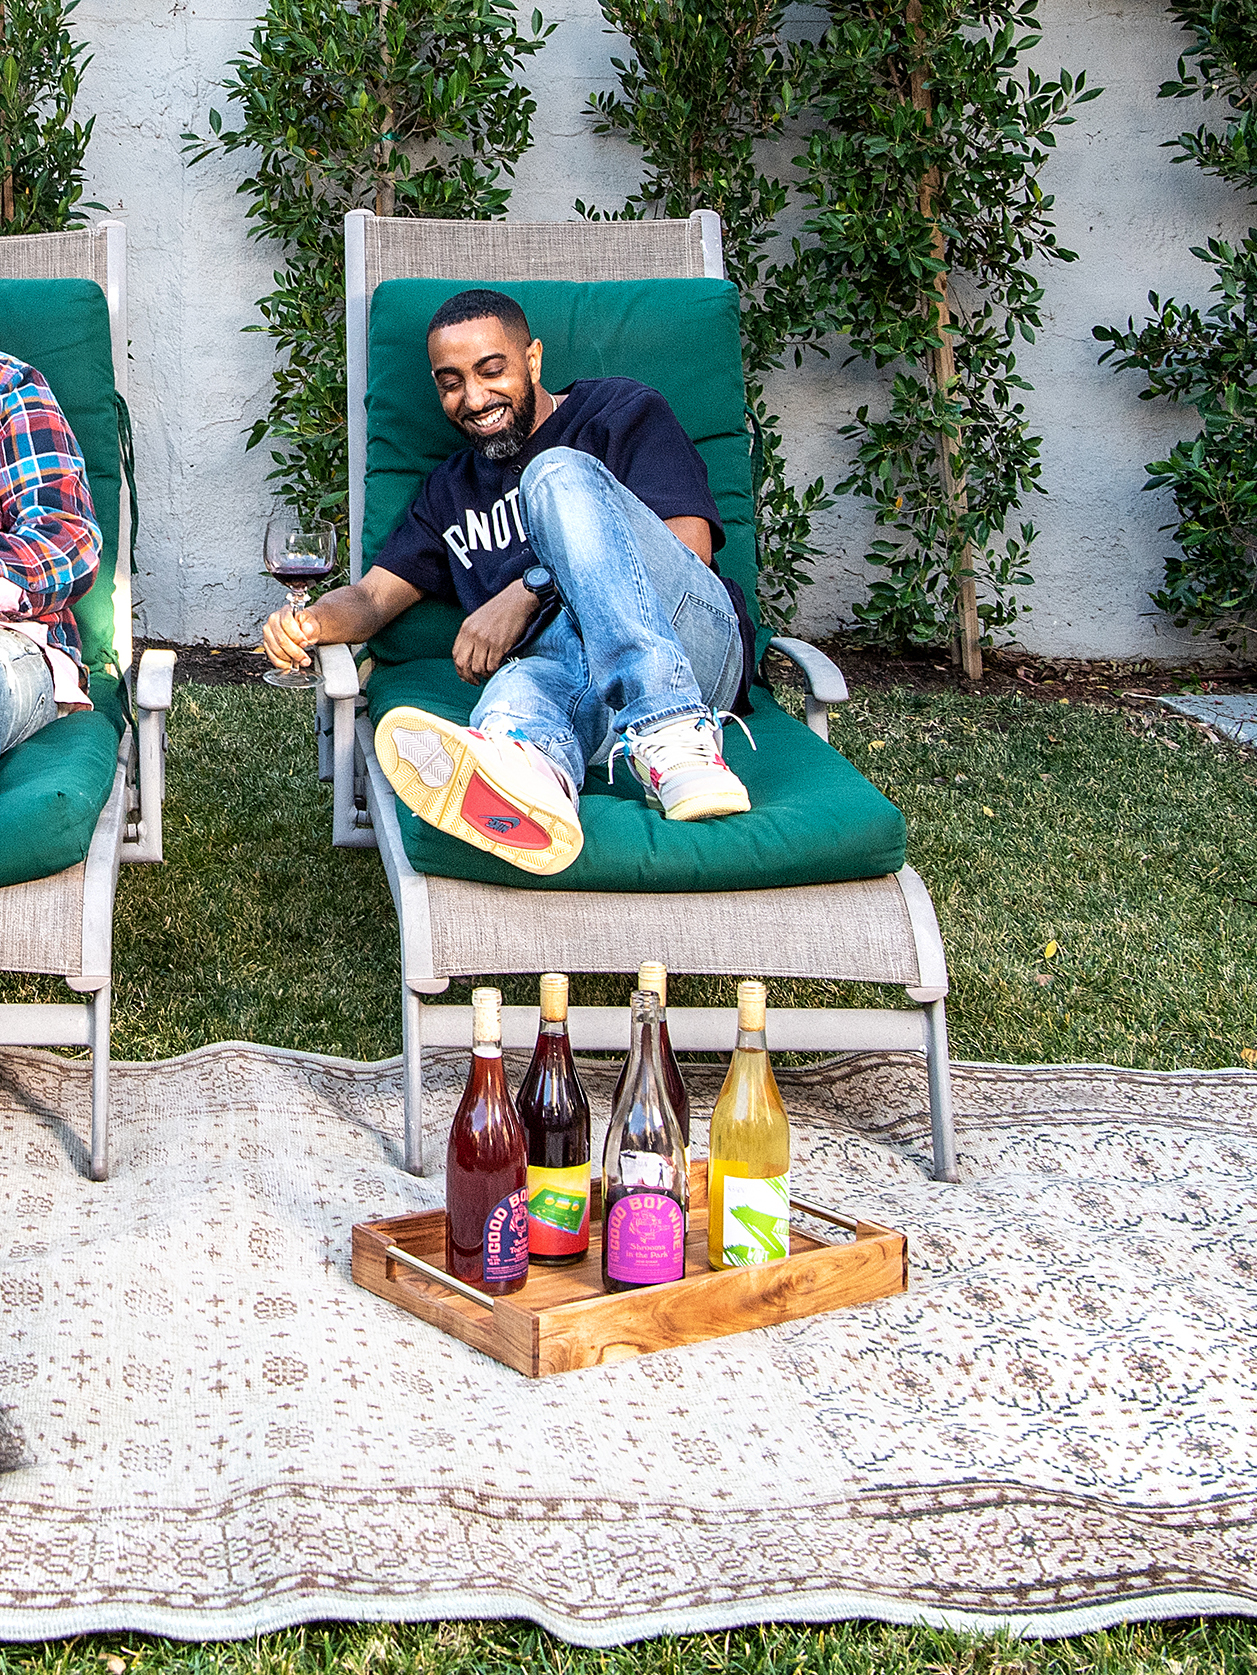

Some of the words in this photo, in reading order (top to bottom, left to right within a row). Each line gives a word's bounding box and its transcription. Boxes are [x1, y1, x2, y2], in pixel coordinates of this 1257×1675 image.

[488, 1207, 509, 1254] GOOD
[508, 1188, 529, 1209] BO
[610, 1206, 627, 1251] GOOD
[628, 1196, 667, 1211] BOY
[668, 1207, 682, 1250] WINE
[635, 1251, 648, 1259] the
